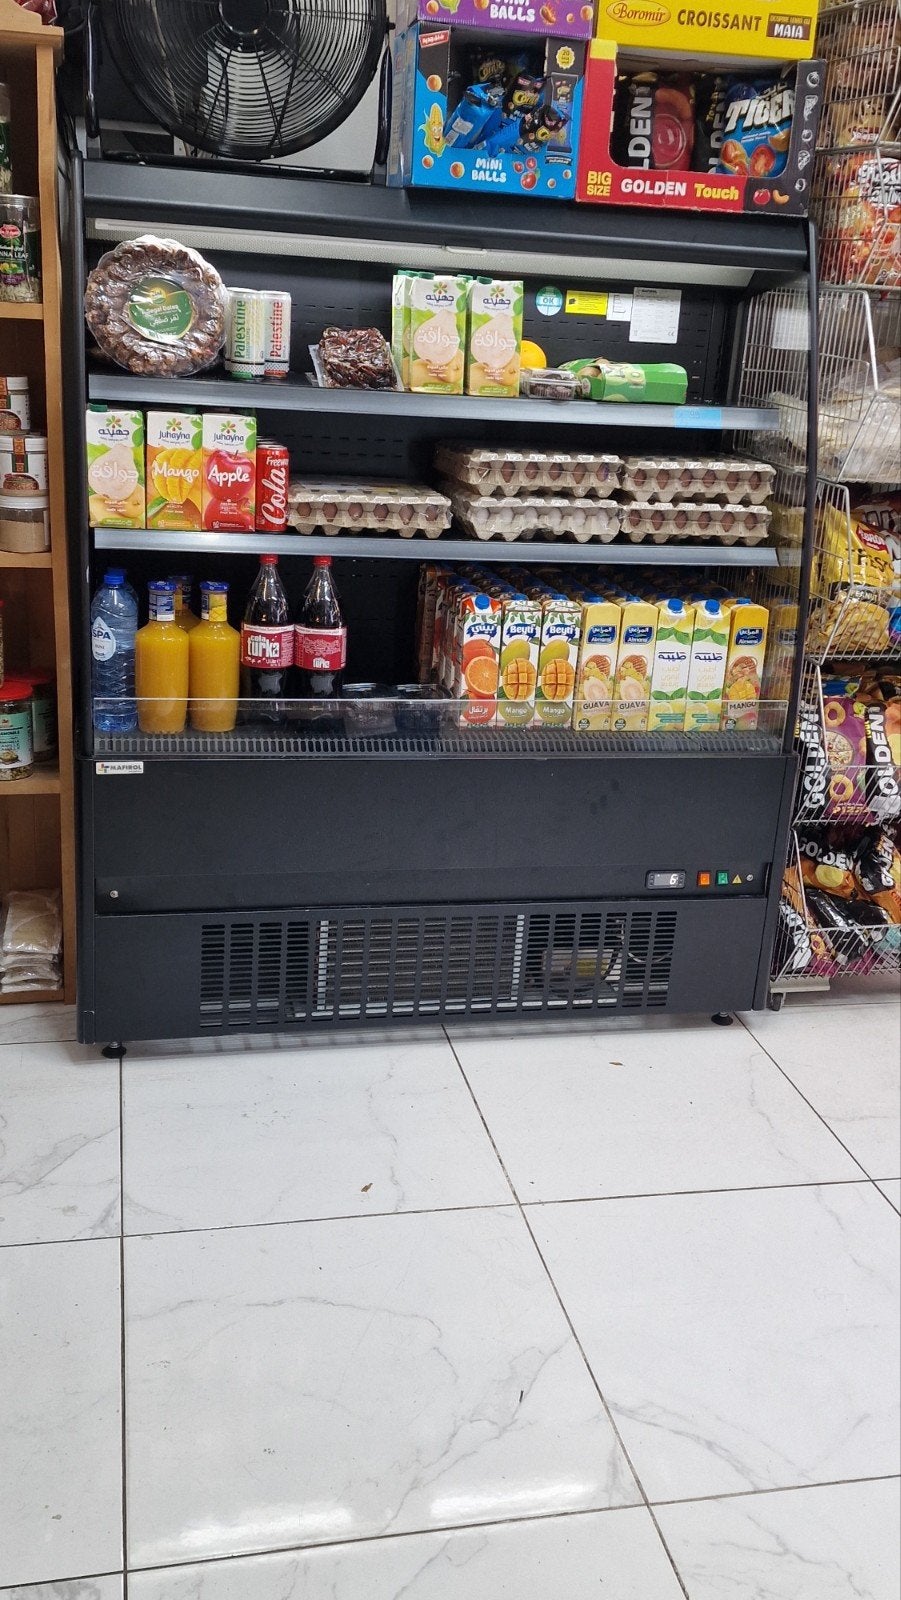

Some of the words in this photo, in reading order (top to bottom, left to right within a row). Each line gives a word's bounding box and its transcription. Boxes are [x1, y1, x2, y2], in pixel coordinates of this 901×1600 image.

[490, 4, 536, 22] BALLS
[612, 2, 667, 23] Boromir
[677, 9, 762, 31] CROISSANT
[774, 23, 803, 39] MAIA
[476, 158, 503, 171] MINI
[472, 170, 507, 183] BALLS
[587, 171, 612, 186] BIG
[587, 185, 611, 196] SIZE
[621, 178, 687, 196] GOLDEN
[694, 182, 740, 201] Touch
[234, 301, 246, 358] Palestine
[270, 302, 282, 358] Palestine
[152, 459, 200, 483] Mango
[208, 464, 251, 487] Apple
[262, 467, 286, 525] Cola
[92, 629, 111, 640] SPA
[510, 625, 534, 635] Beyti
[549, 625, 574, 635] Beyti
[505, 706, 527, 715] Mango
[543, 706, 565, 715] Mango
[583, 701, 610, 709] GUAVA
[619, 701, 646, 709] GUAVA
